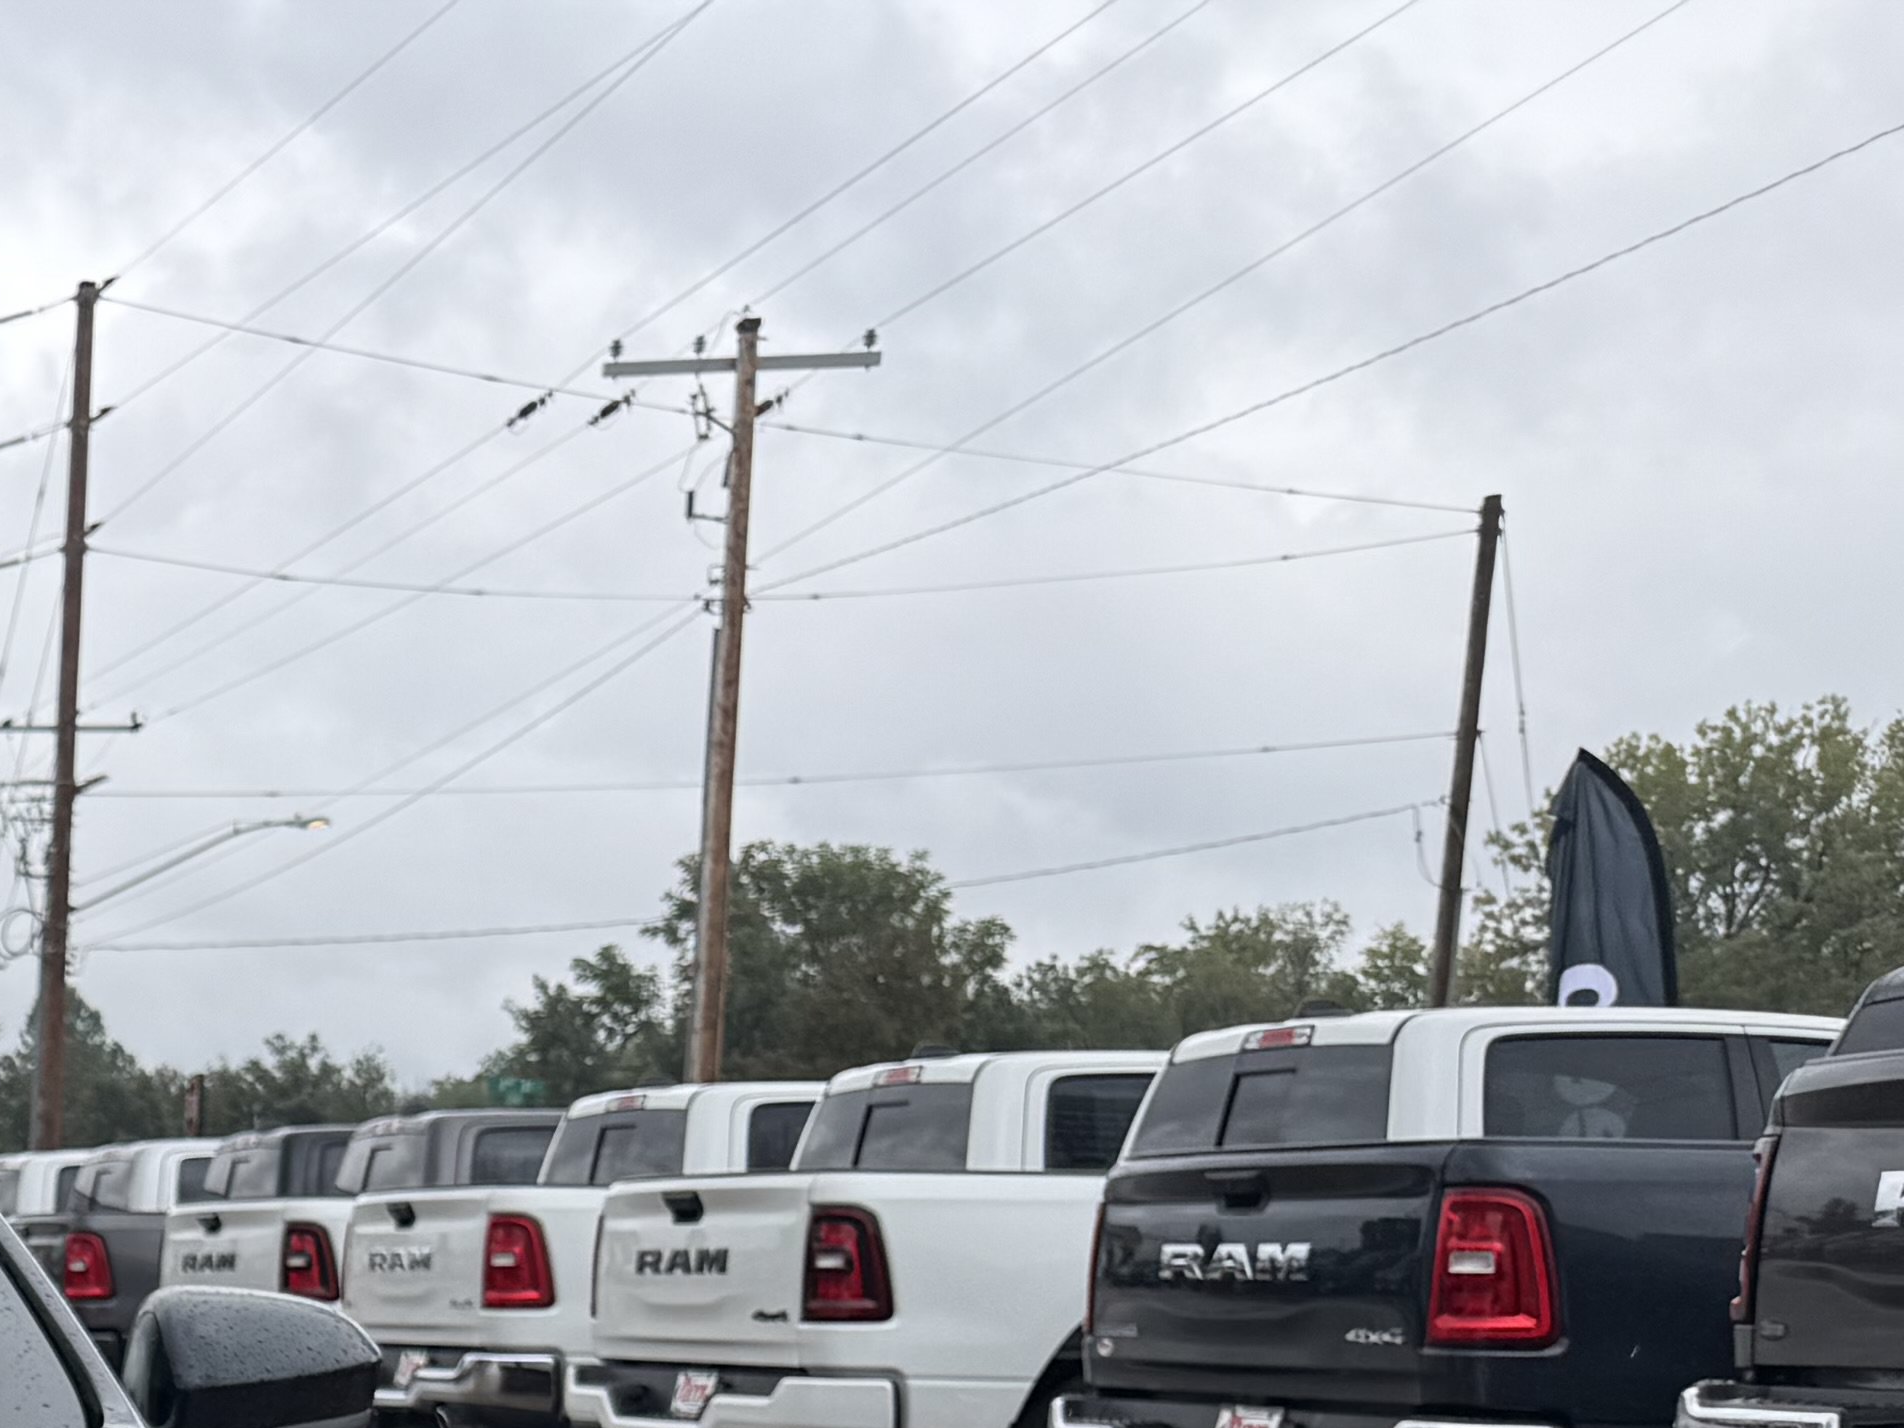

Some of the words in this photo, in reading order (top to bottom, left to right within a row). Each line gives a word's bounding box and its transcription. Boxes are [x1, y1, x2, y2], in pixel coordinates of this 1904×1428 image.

[181, 1252, 237, 1273] RAM
[368, 1248, 433, 1273] RAM
[635, 1248, 730, 1275] RAM
[1158, 1242, 1311, 1281] RAM
